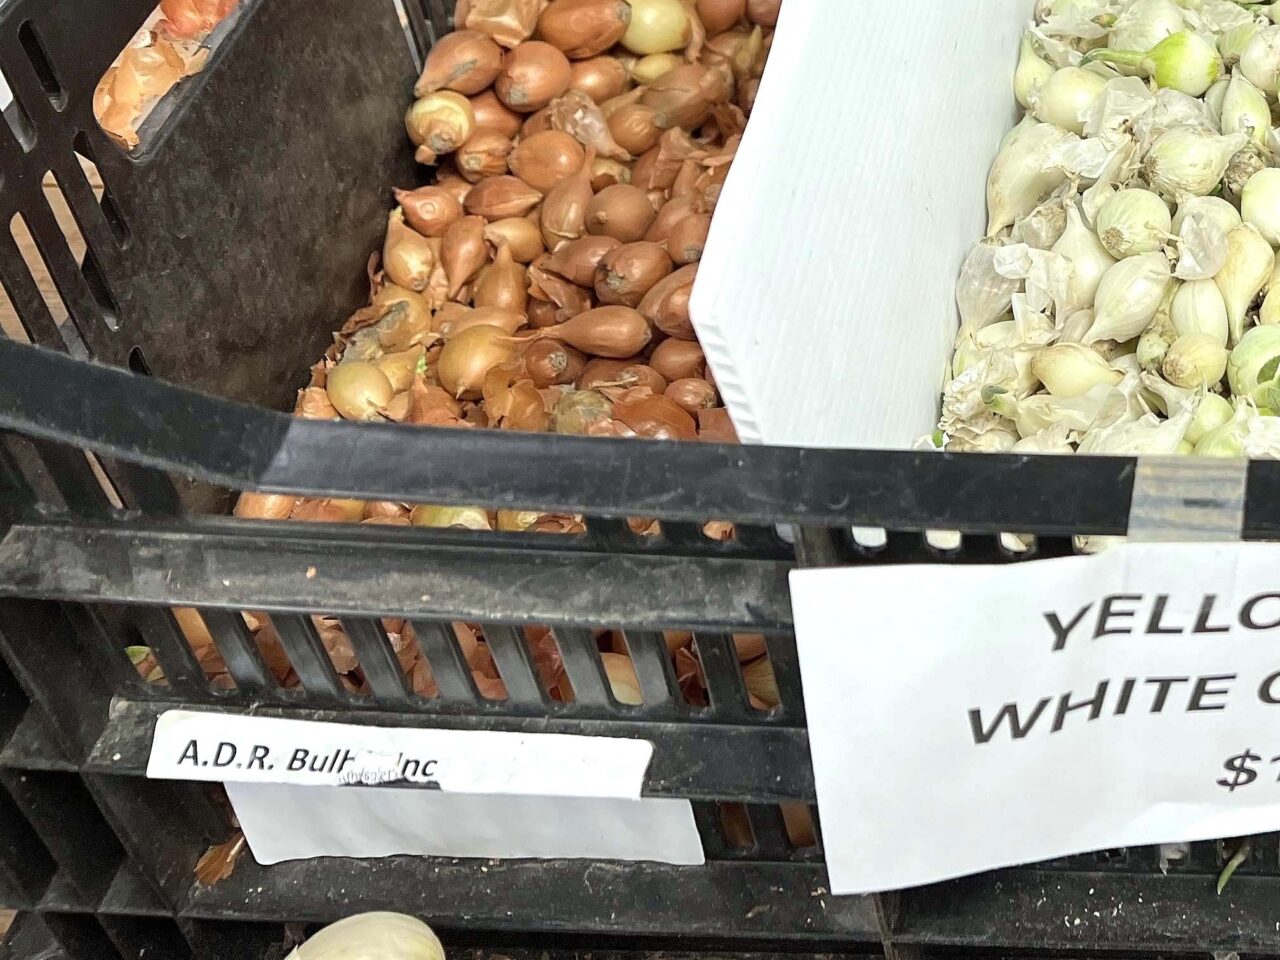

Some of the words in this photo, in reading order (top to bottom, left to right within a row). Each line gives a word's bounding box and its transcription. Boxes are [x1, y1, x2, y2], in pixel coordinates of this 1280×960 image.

[968, 675, 1238, 744] WHITE
[177, 739, 275, 772] A.D.R.
[286, 748, 362, 775] Bul
